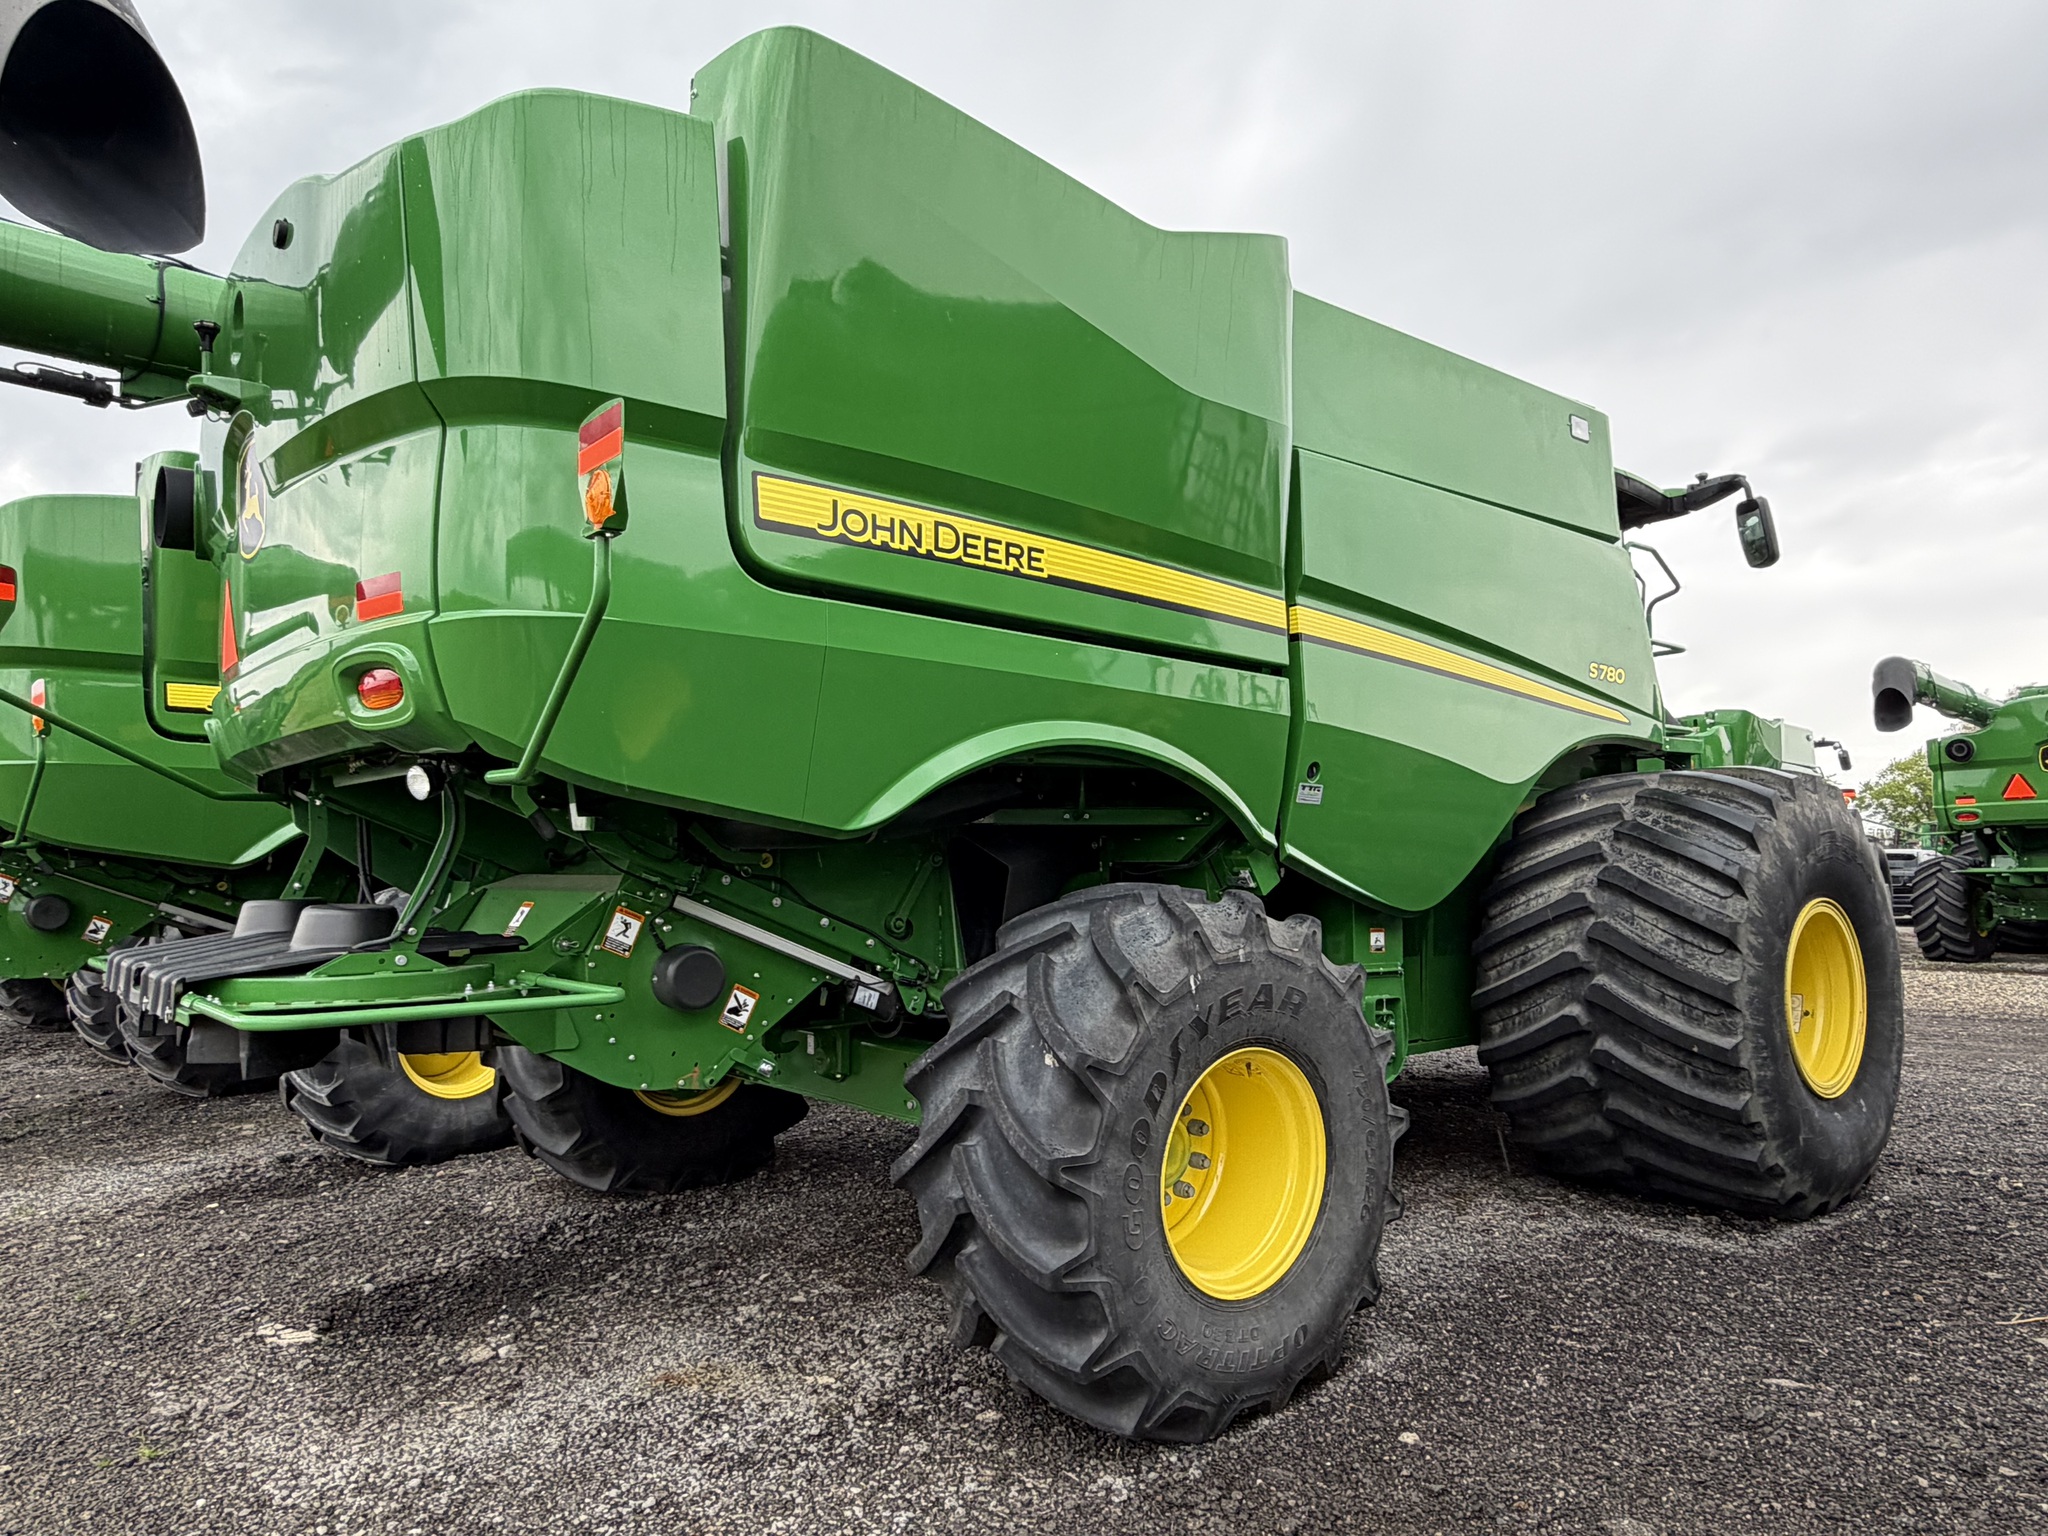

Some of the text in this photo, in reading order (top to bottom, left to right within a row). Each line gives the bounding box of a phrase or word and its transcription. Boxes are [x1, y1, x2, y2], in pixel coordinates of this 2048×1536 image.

[816, 498, 1046, 573] JOHN DEERE
[1589, 662, 1626, 685] S780
[1157, 1317, 1309, 1375] OPTITRAC
